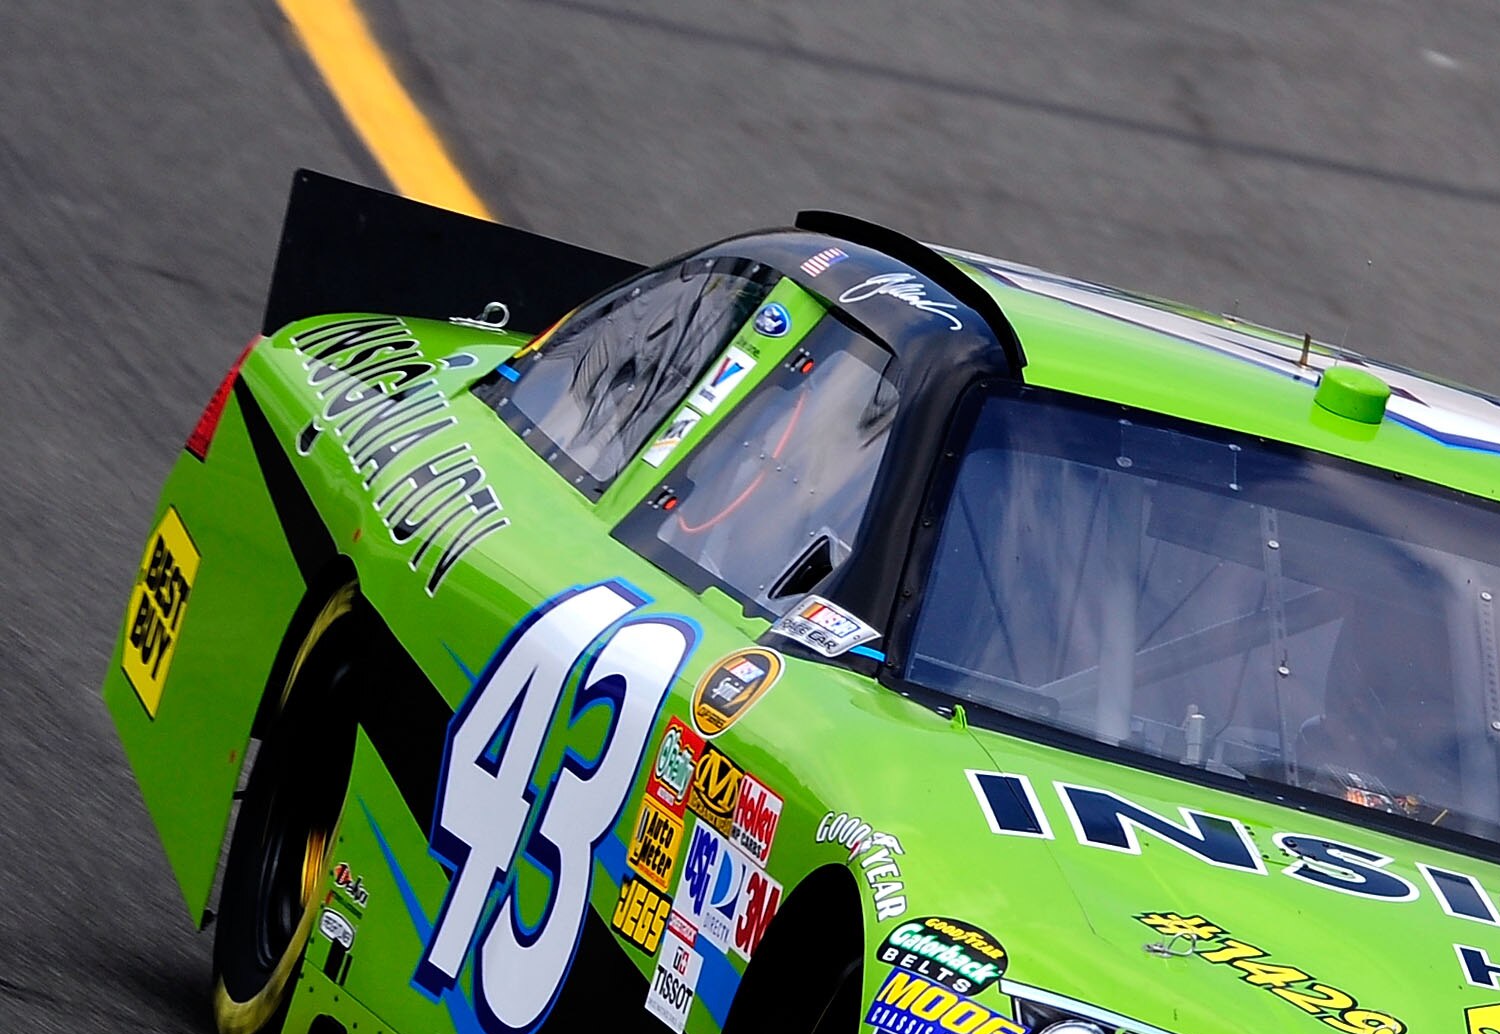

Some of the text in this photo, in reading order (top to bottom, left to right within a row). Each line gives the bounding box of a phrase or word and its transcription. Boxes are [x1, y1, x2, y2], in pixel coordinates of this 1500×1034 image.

[290, 317, 510, 598] INSIGNIA HDTV
[146, 534, 190, 632] BEST
[130, 590, 172, 681] BUY
[808, 630, 838, 651] CAR
[647, 811, 674, 849] Auto
[734, 778, 778, 862] Holley
[639, 835, 672, 878] Meter
[613, 879, 671, 953] JEGS
[735, 871, 781, 958] 3M
[925, 918, 1004, 960] GOODYEAR
[882, 947, 971, 993] BELTS
[889, 922, 999, 985] Gatorback
[653, 965, 693, 1015] TISSOT
